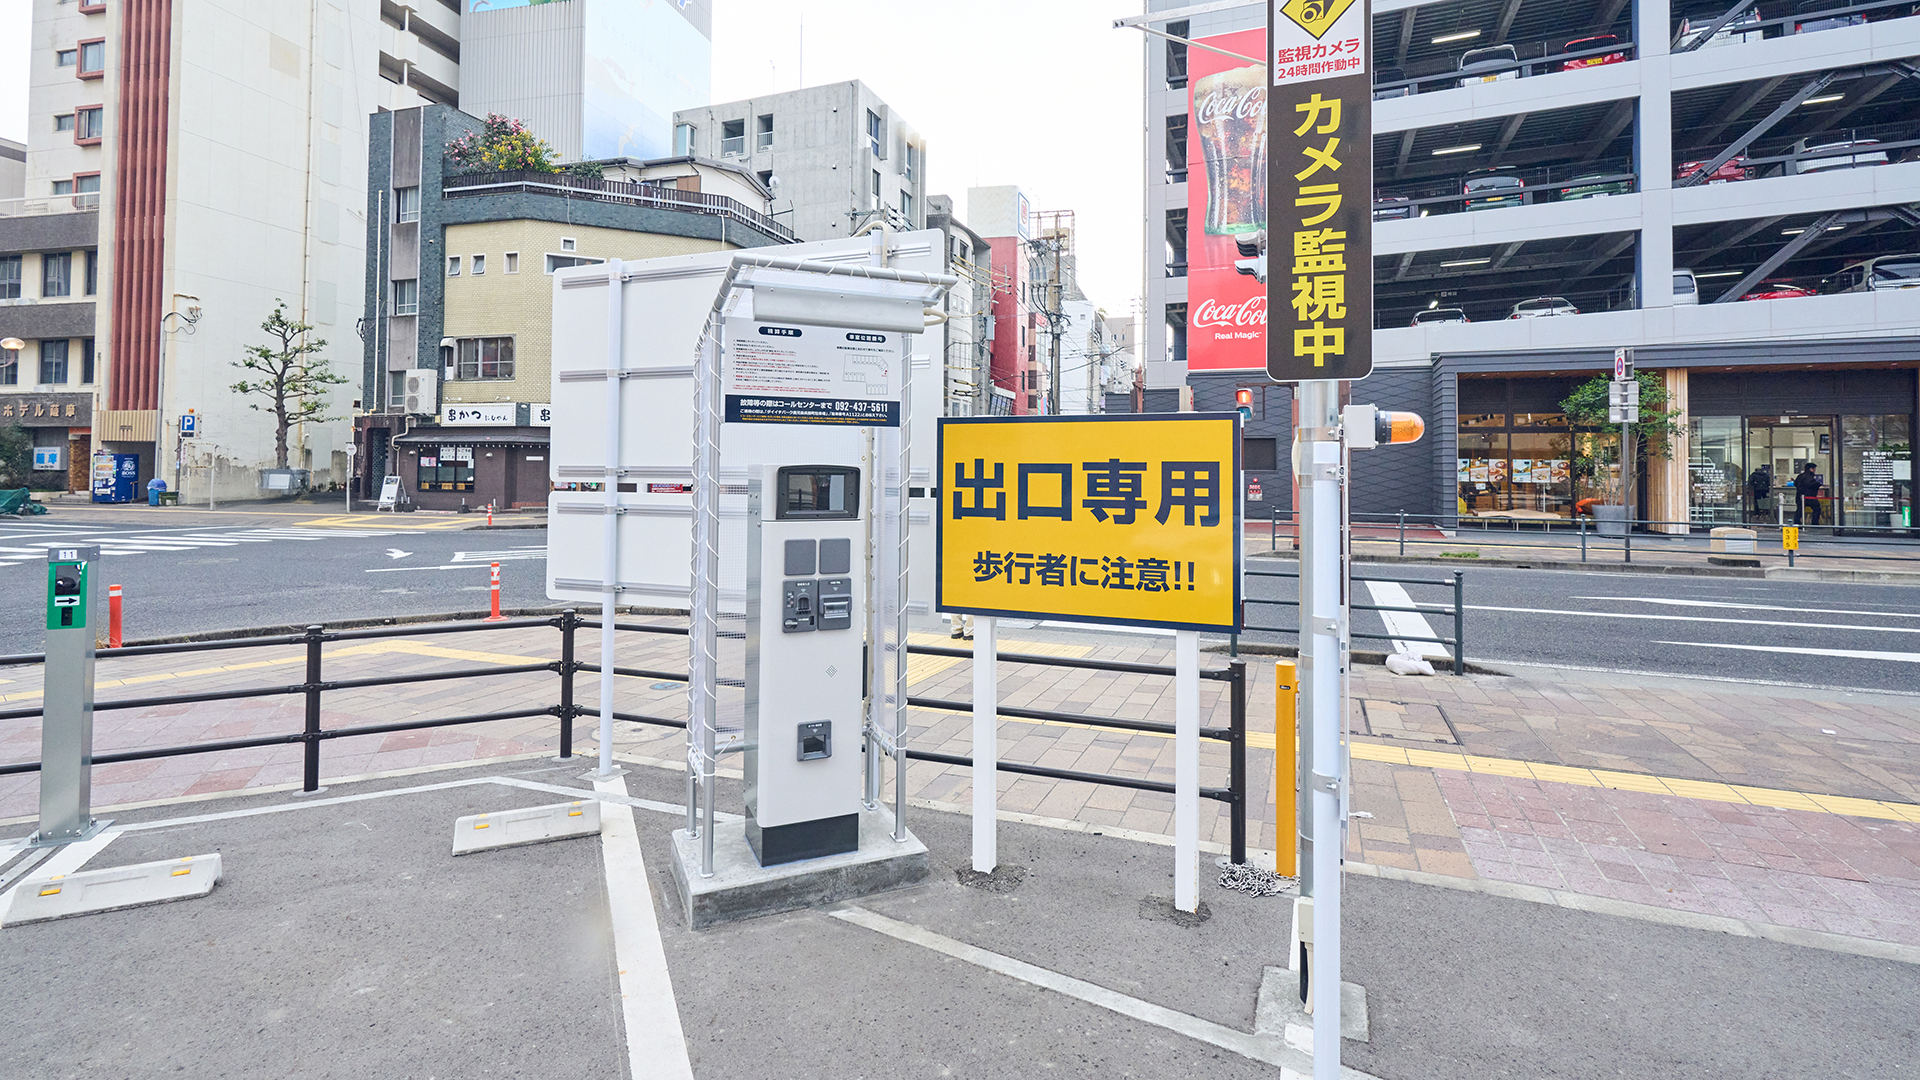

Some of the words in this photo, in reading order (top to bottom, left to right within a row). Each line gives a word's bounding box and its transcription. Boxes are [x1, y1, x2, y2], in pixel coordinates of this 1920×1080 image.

[1278, 38, 1360, 64] 監視カメラ
[1278, 56, 1360, 79] 24時間作動中
[1291, 93, 1347, 367] カメラ監視中
[1215, 332, 1233, 340] Real
[448, 408, 481, 422] 串かつ
[540, 408, 550, 422] 串
[835, 401, 888, 413] 092-437-5611
[183, 416, 193, 430] P
[952, 458, 1220, 527] 出口専用
[973, 550, 1195, 592] 歩行者に注意!!
